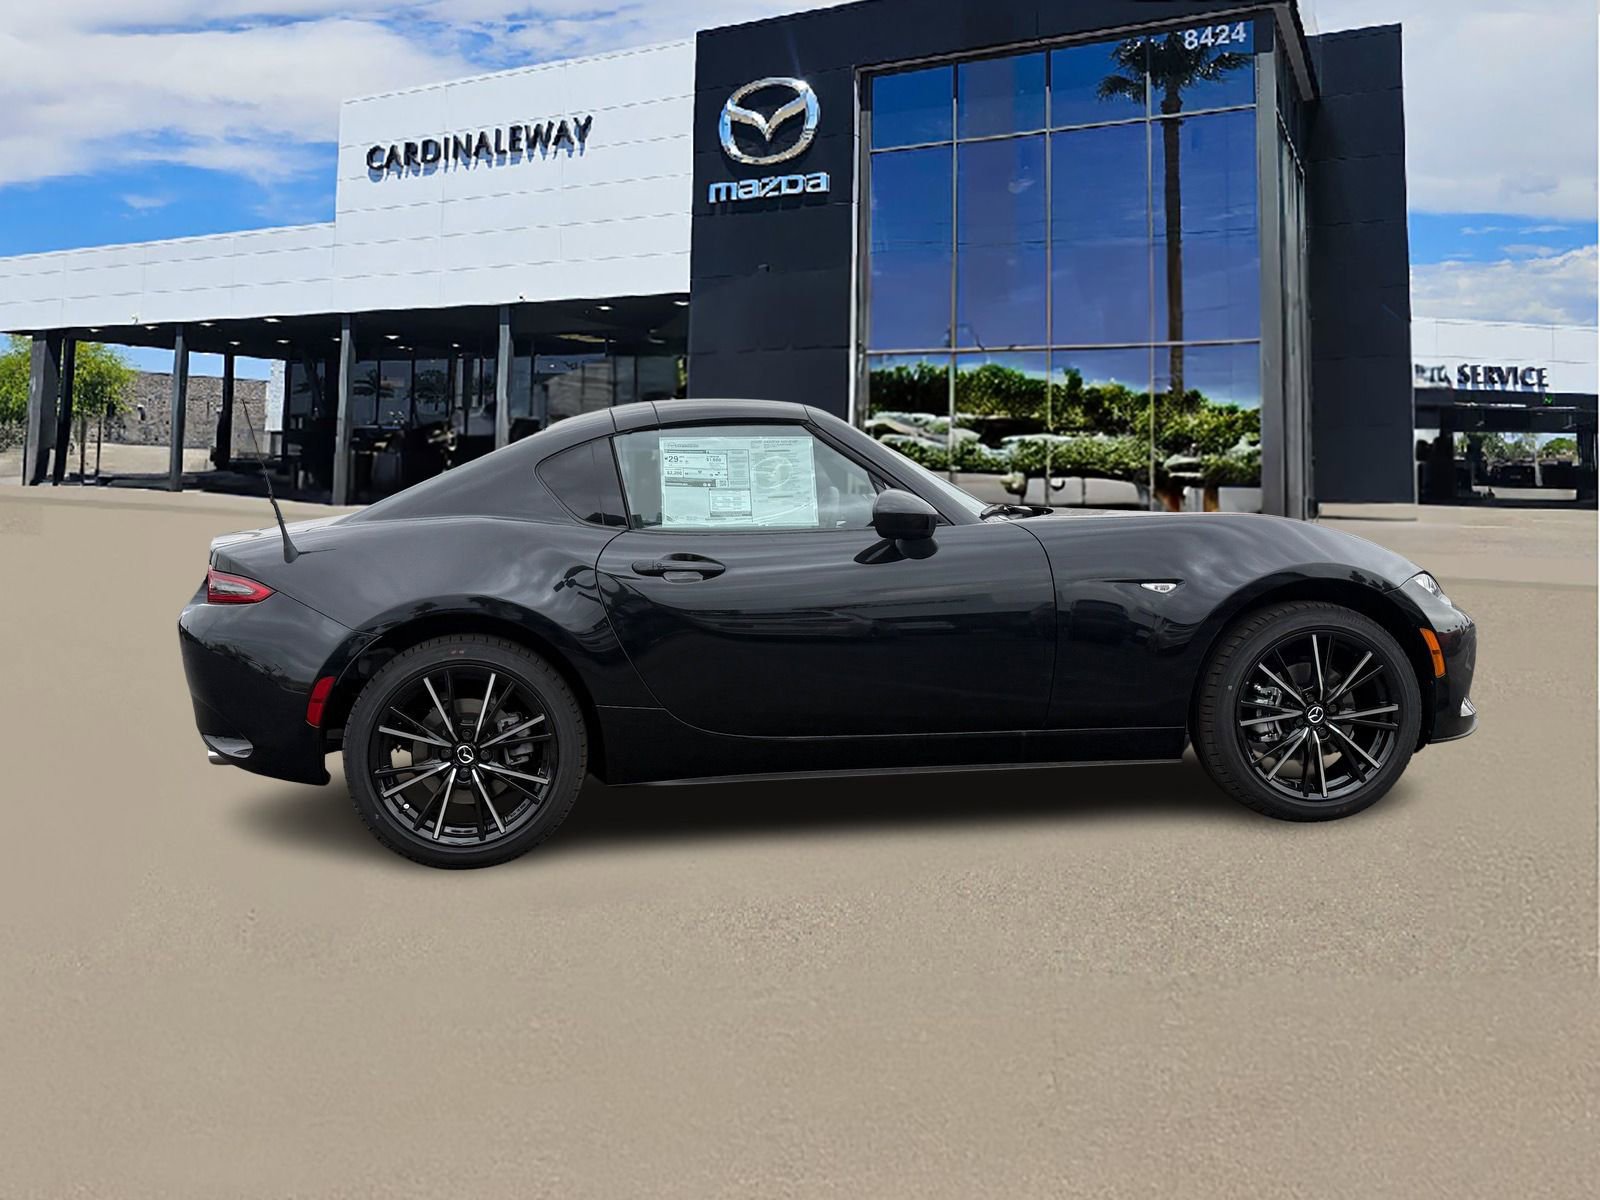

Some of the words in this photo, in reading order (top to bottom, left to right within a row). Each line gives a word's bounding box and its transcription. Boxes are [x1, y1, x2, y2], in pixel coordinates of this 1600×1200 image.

[1184, 21, 1246, 50] 8424
[366, 114, 593, 170] CARDINALEWAY
[708, 172, 830, 203] mazda
[1457, 363, 1549, 387] SERVICE
[668, 455, 679, 463] 29
